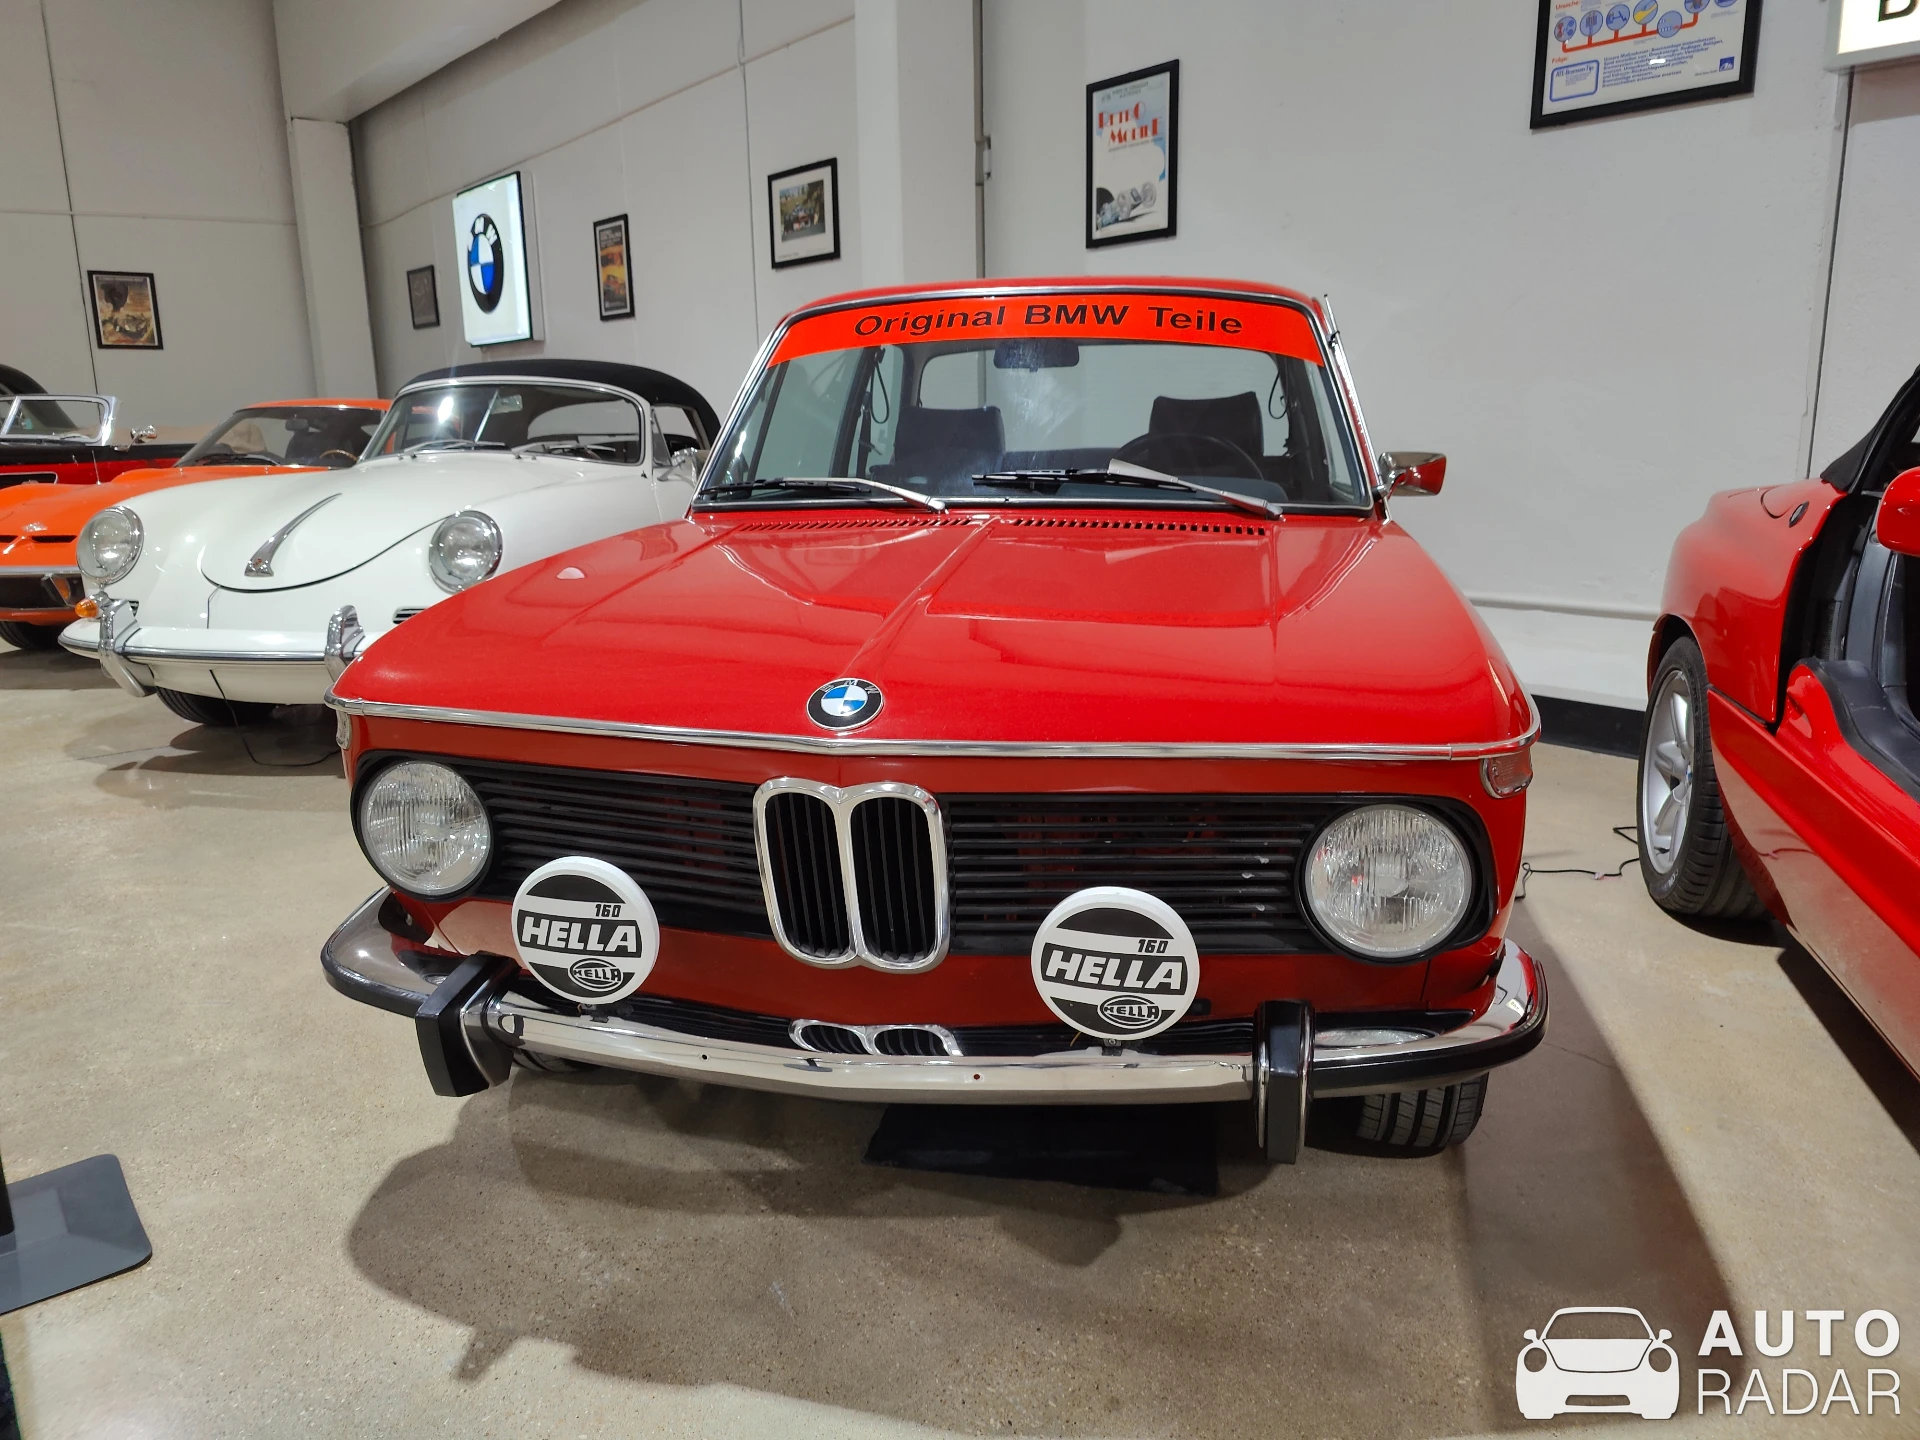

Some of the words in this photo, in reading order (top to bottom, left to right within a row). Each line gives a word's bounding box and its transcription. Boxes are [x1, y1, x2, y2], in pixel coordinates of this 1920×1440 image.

[854, 306, 1005, 336] Original
[1024, 304, 1130, 325] BMW
[1147, 306, 1243, 334] Teile
[595, 903, 621, 918] 160
[521, 916, 637, 953] HELLA
[1137, 939, 1169, 954] 160
[573, 968, 622, 982] HELLA
[1045, 949, 1183, 990] HELLA
[1103, 1005, 1160, 1020] HELLA
